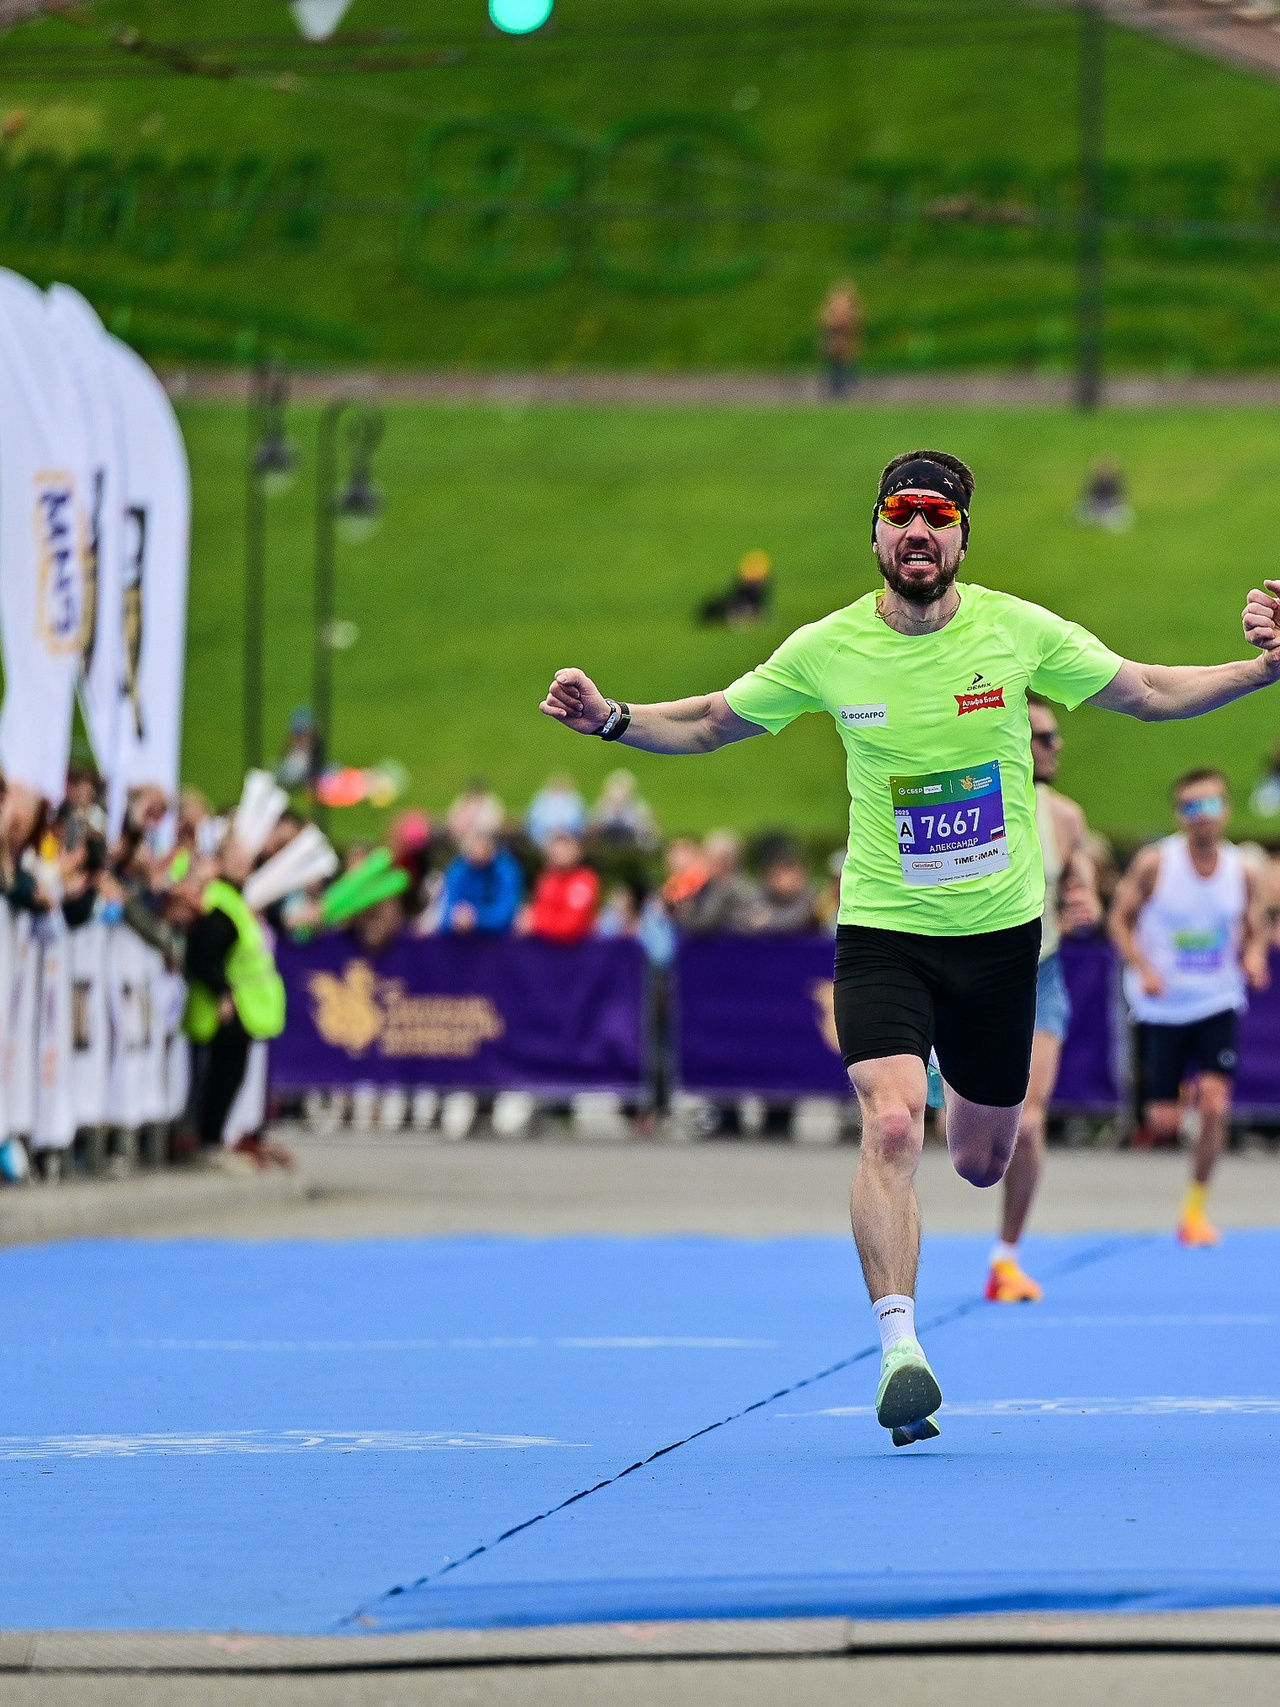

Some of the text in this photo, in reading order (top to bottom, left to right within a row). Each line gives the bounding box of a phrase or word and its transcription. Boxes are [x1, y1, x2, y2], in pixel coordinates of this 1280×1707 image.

[966, 682, 992, 691] DEMIX
[962, 694, 1000, 710] Альфа Банк
[848, 711, 885, 720] ФОСАГРО
[920, 807, 980, 839] 7667
[929, 837, 979, 853] АЛЕКСАНДР
